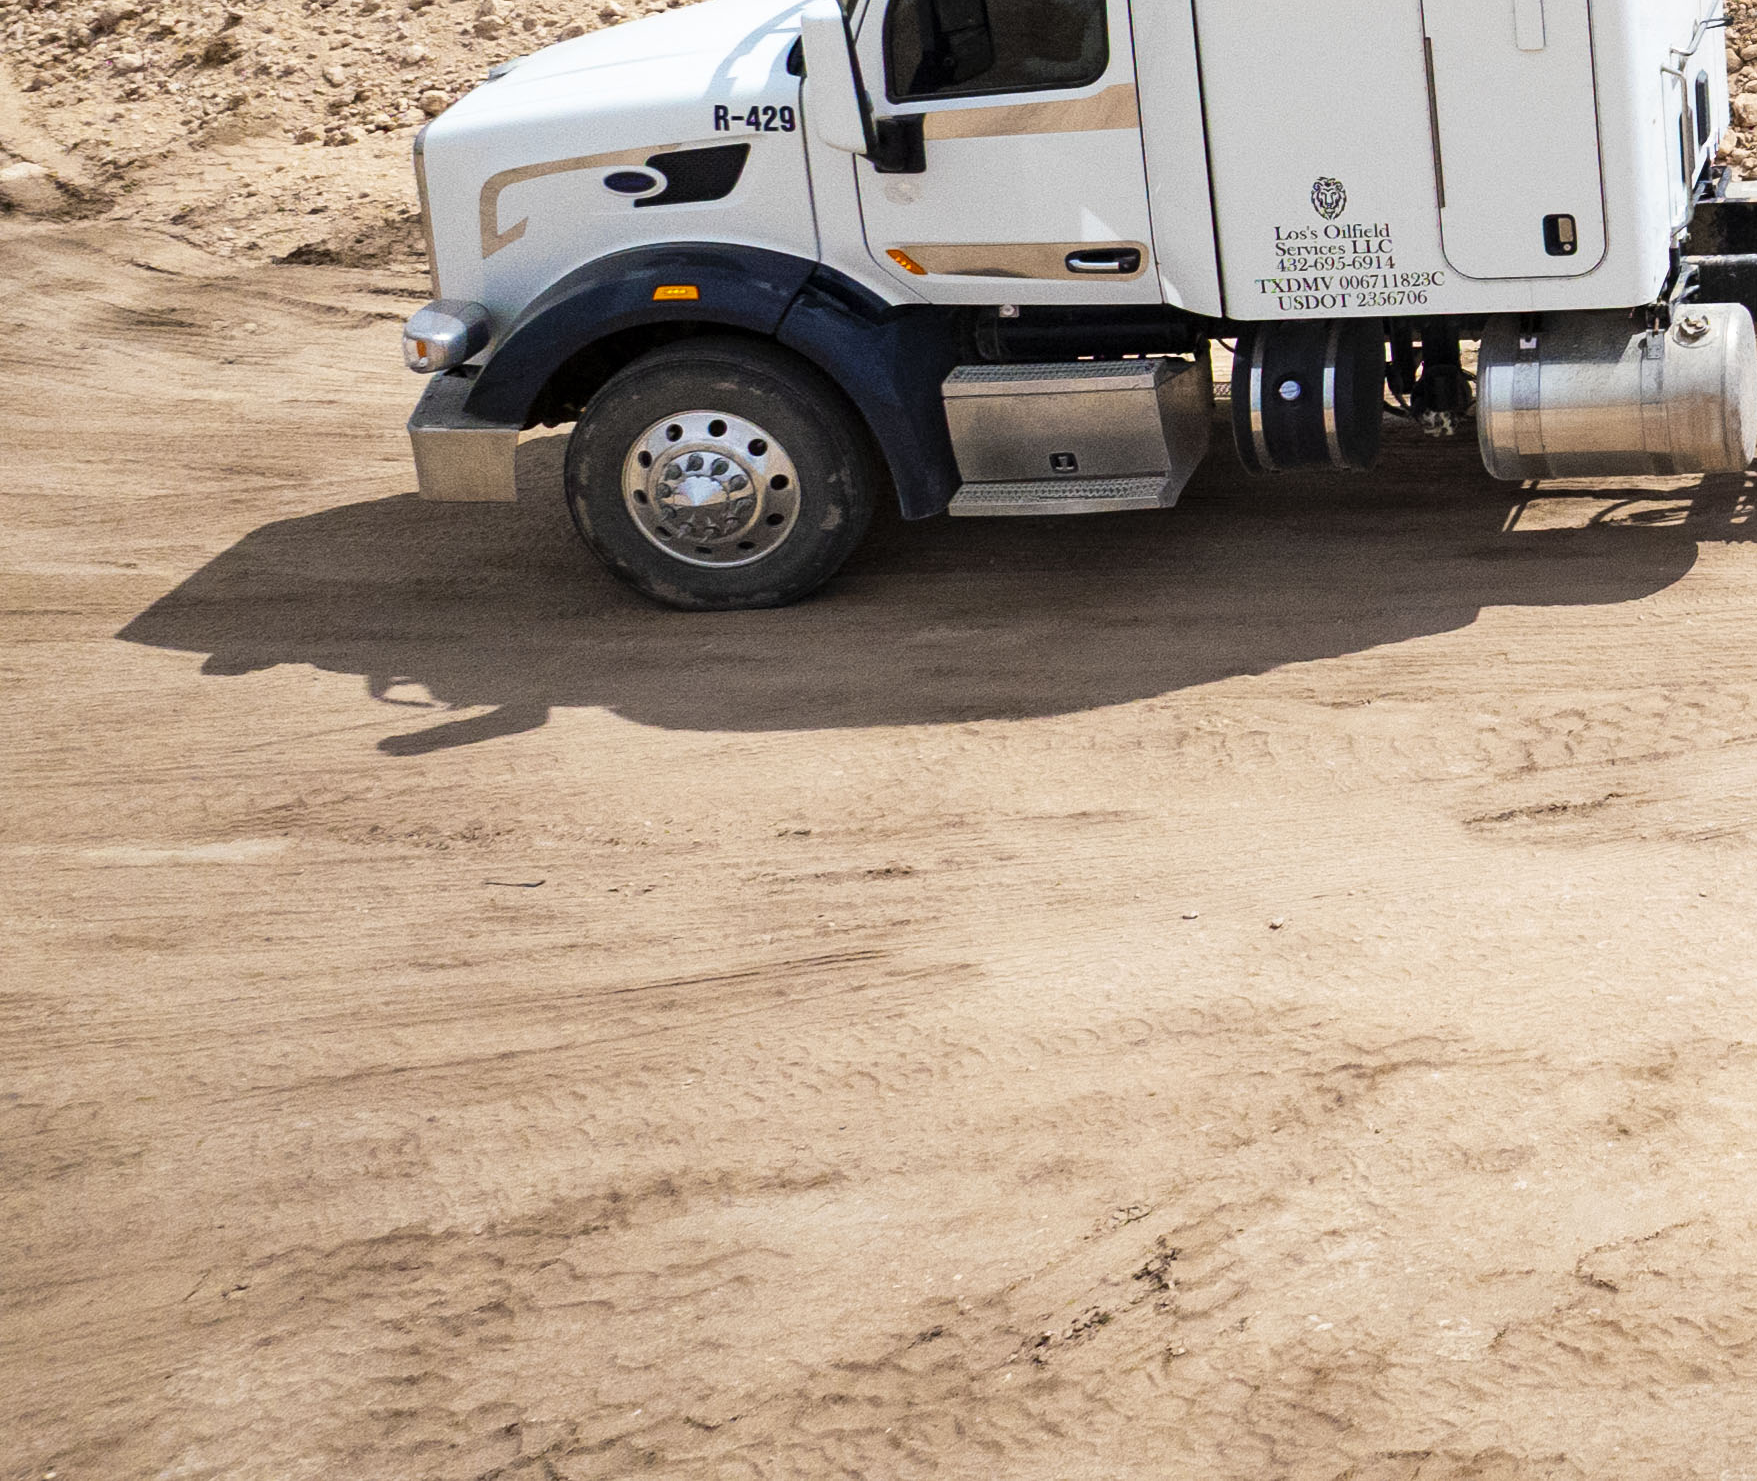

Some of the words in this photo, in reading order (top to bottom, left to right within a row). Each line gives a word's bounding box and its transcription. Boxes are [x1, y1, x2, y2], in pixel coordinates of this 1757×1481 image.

[714, 104, 797, 132] R-429
[1323, 223, 1391, 238] Oilfield
[1275, 241, 1346, 256] Services
[1352, 239, 1393, 254] LLC
[1277, 255, 1396, 272] 432-695-6914
[1254, 277, 1334, 294] TXDMV
[1339, 271, 1446, 290] 006711823C
[1278, 293, 1351, 311] USDOT
[1356, 289, 1428, 307] 2356706
